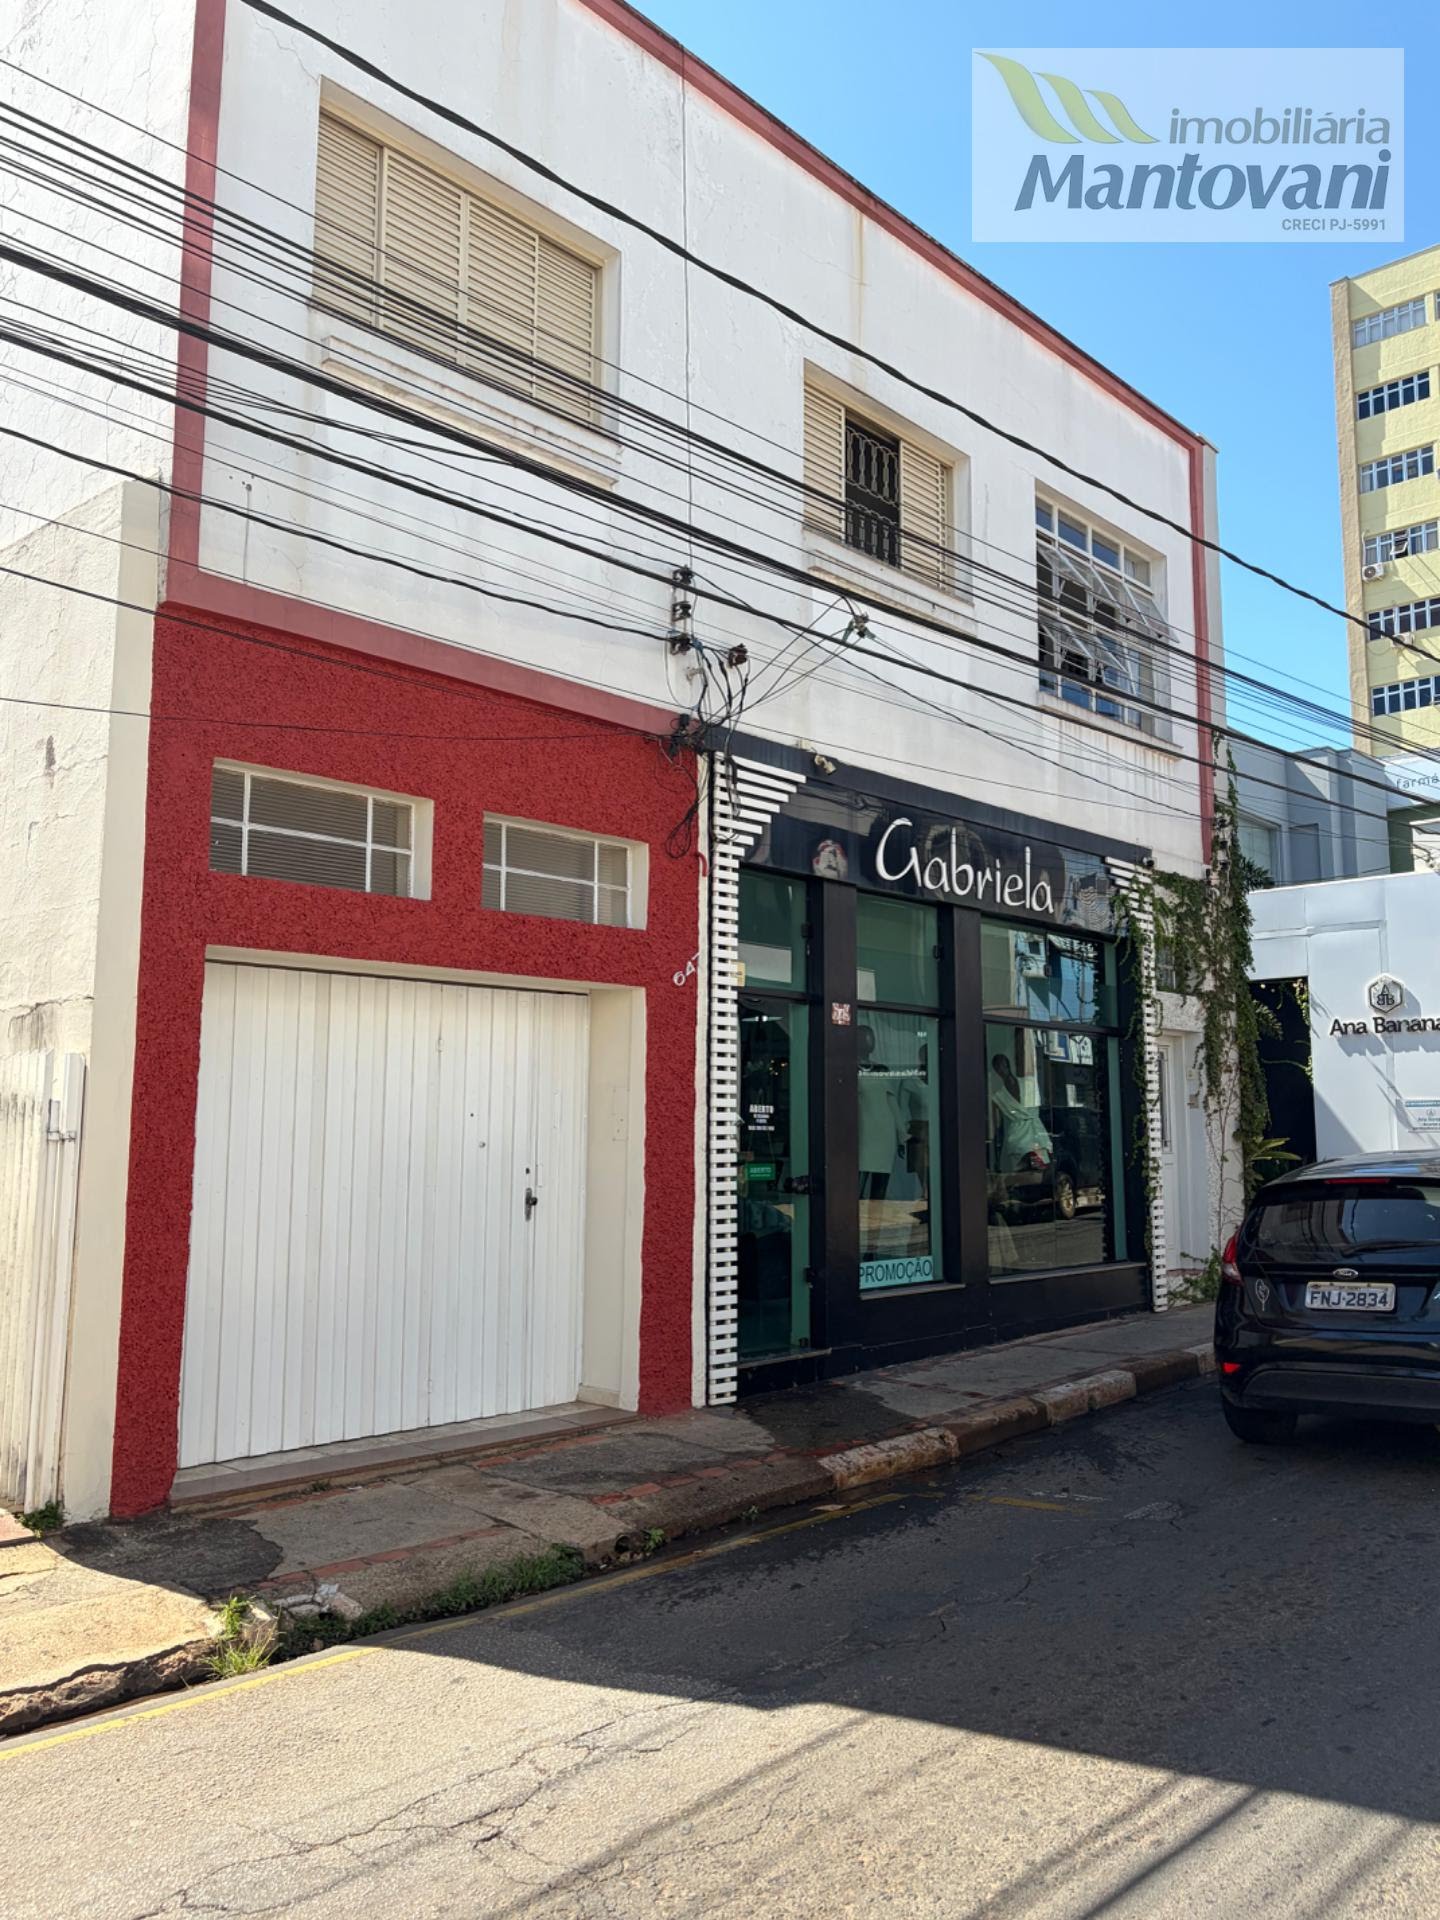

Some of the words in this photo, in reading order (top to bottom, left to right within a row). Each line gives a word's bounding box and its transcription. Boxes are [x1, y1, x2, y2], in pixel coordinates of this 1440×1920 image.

[875, 817, 1054, 914] Gabriela
[1329, 1018, 1368, 1036] Ana
[859, 1257, 933, 1283] PROMOÇÃO
